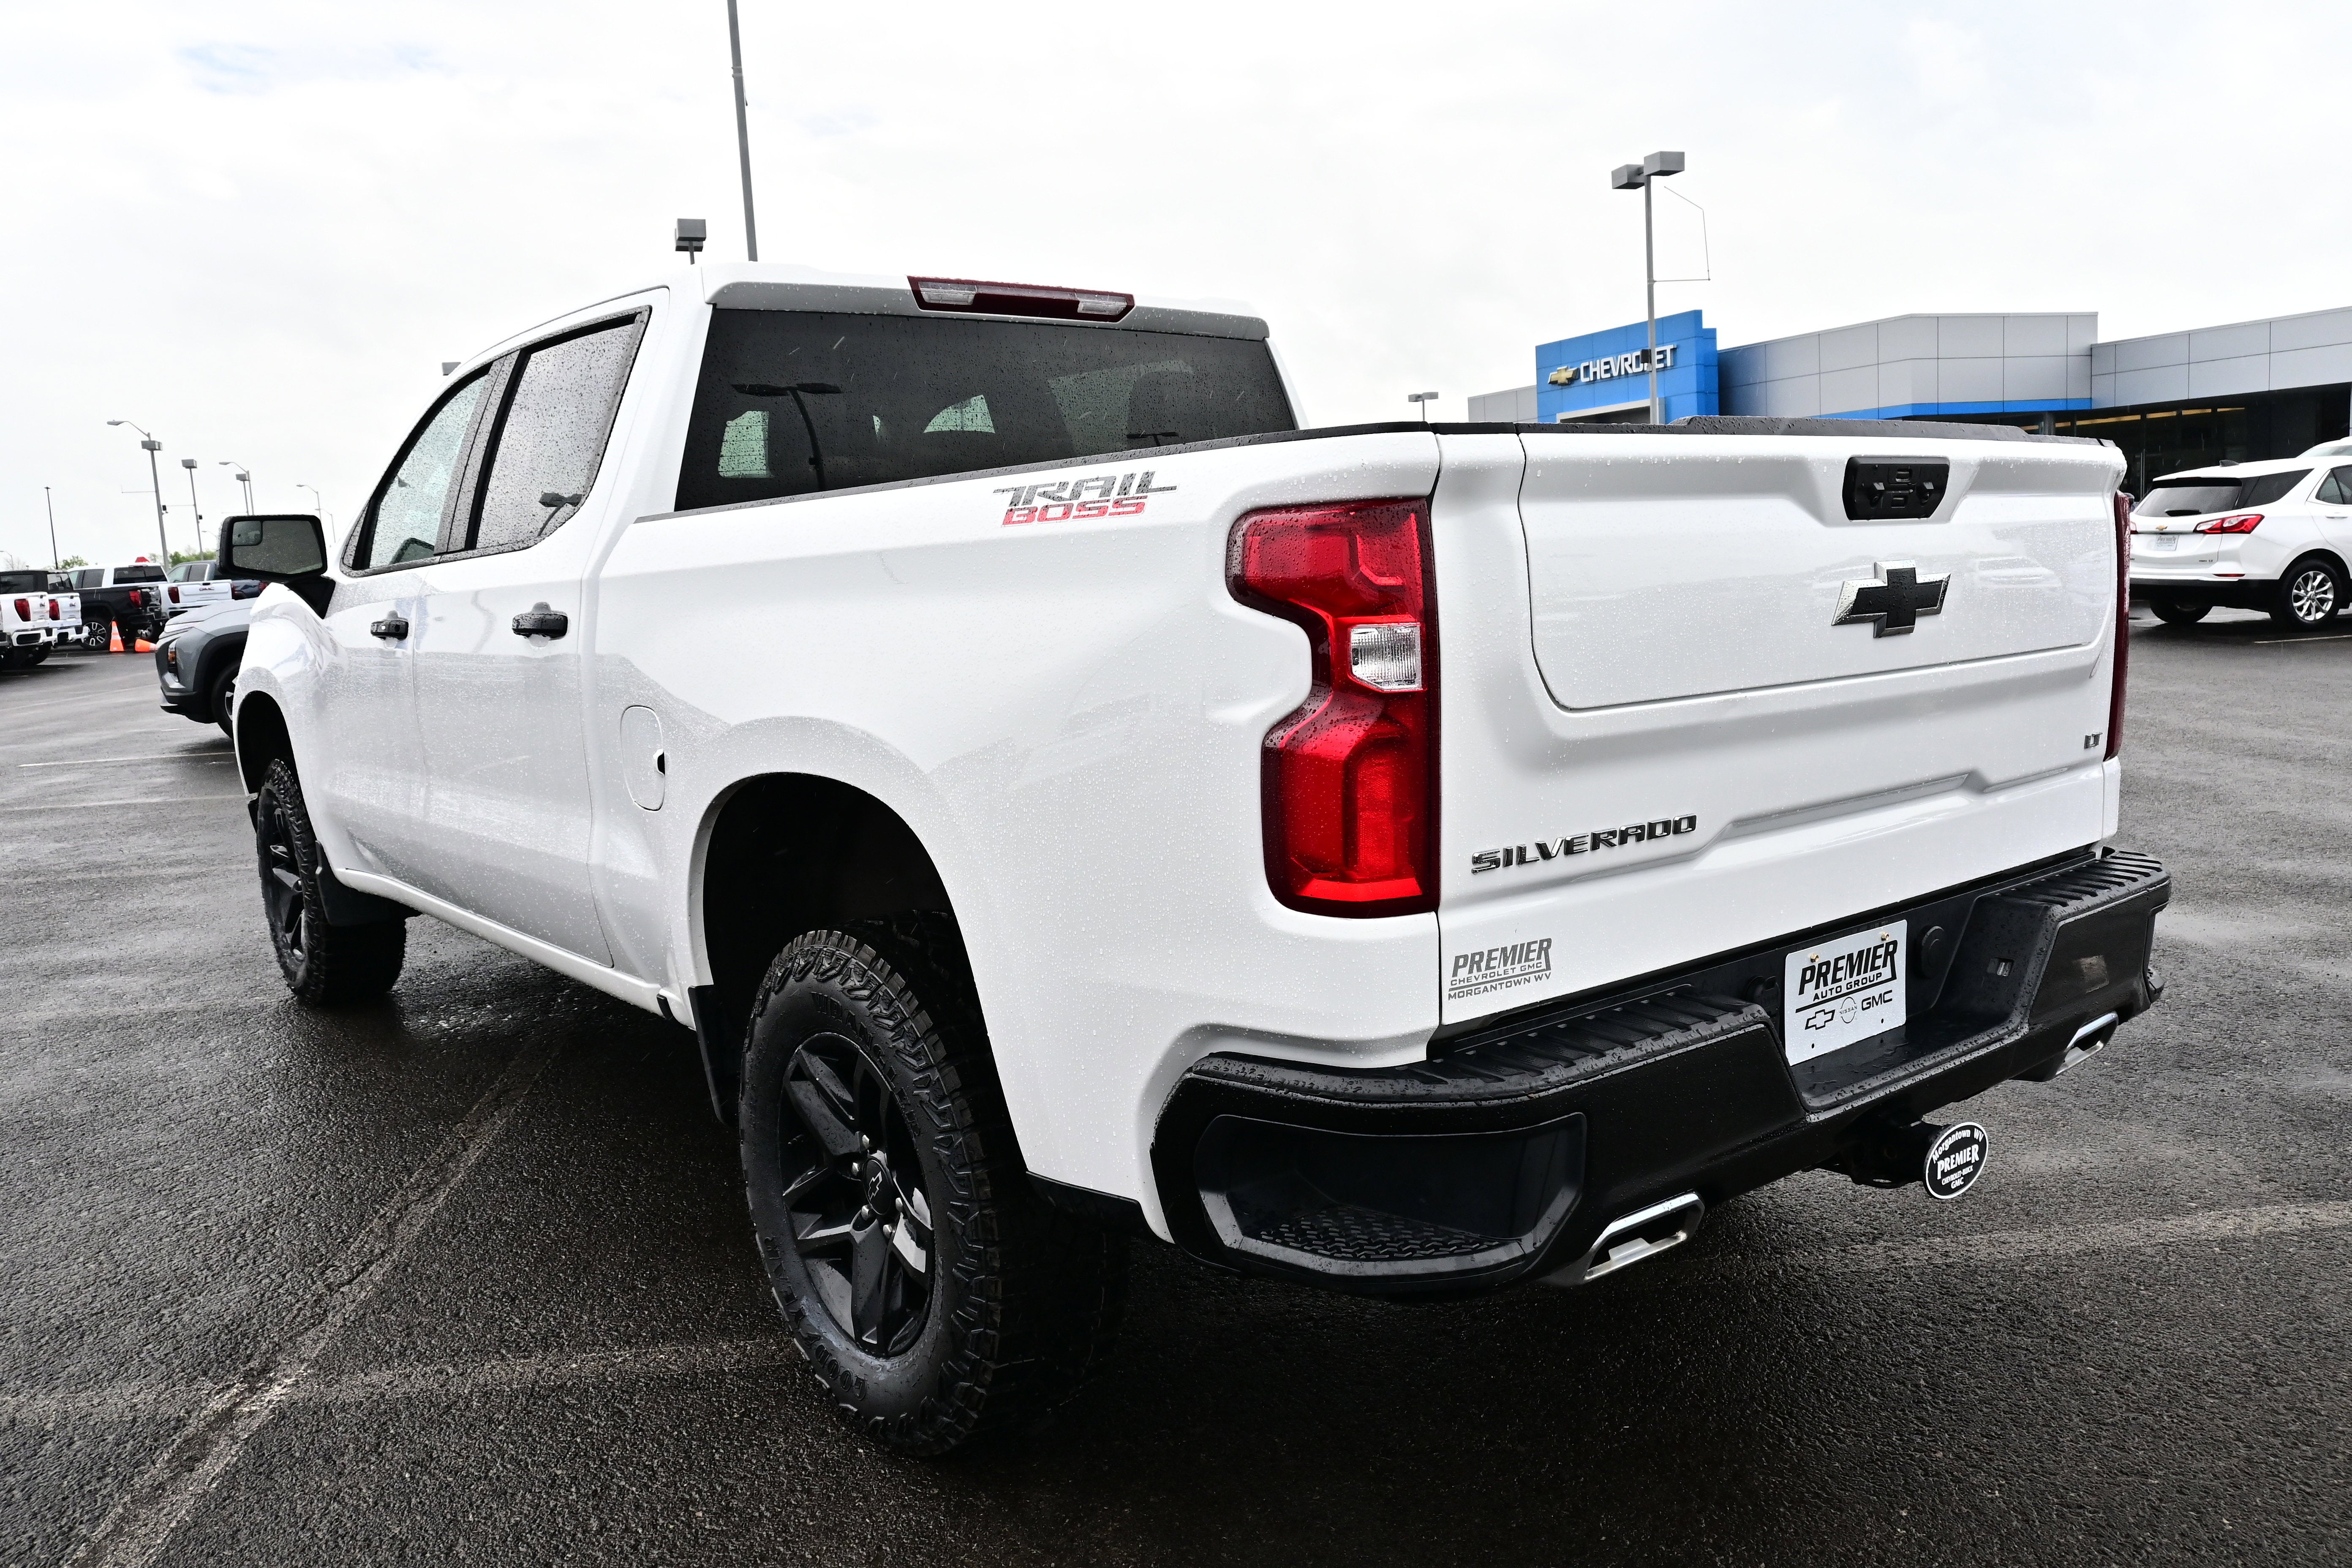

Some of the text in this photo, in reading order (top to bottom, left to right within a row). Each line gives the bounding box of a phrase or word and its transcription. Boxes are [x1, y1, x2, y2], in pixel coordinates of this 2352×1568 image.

[1580, 344, 1677, 382] CHEVROET
[993, 471, 1177, 507] TRAIL
[1002, 495, 1148, 525] BOSS
[2084, 732, 2103, 749] LT
[1471, 814, 1697, 875] SILVERADO
[1450, 961, 1543, 986] CHEVROLET GMC
[1452, 938, 1552, 978] PREMIER
[1798, 939, 1898, 996] PREMIER
[1448, 971, 1552, 1001] MORGANTOWN WV
[1813, 972, 1882, 1002] AUTO GROUP
[1839, 989, 1893, 1015] NISSAN GMC
[1932, 1128, 1984, 1164] Morgantown WV
[1937, 1144, 1979, 1180] PREMIER
[1951, 1176, 1964, 1189] GMC
